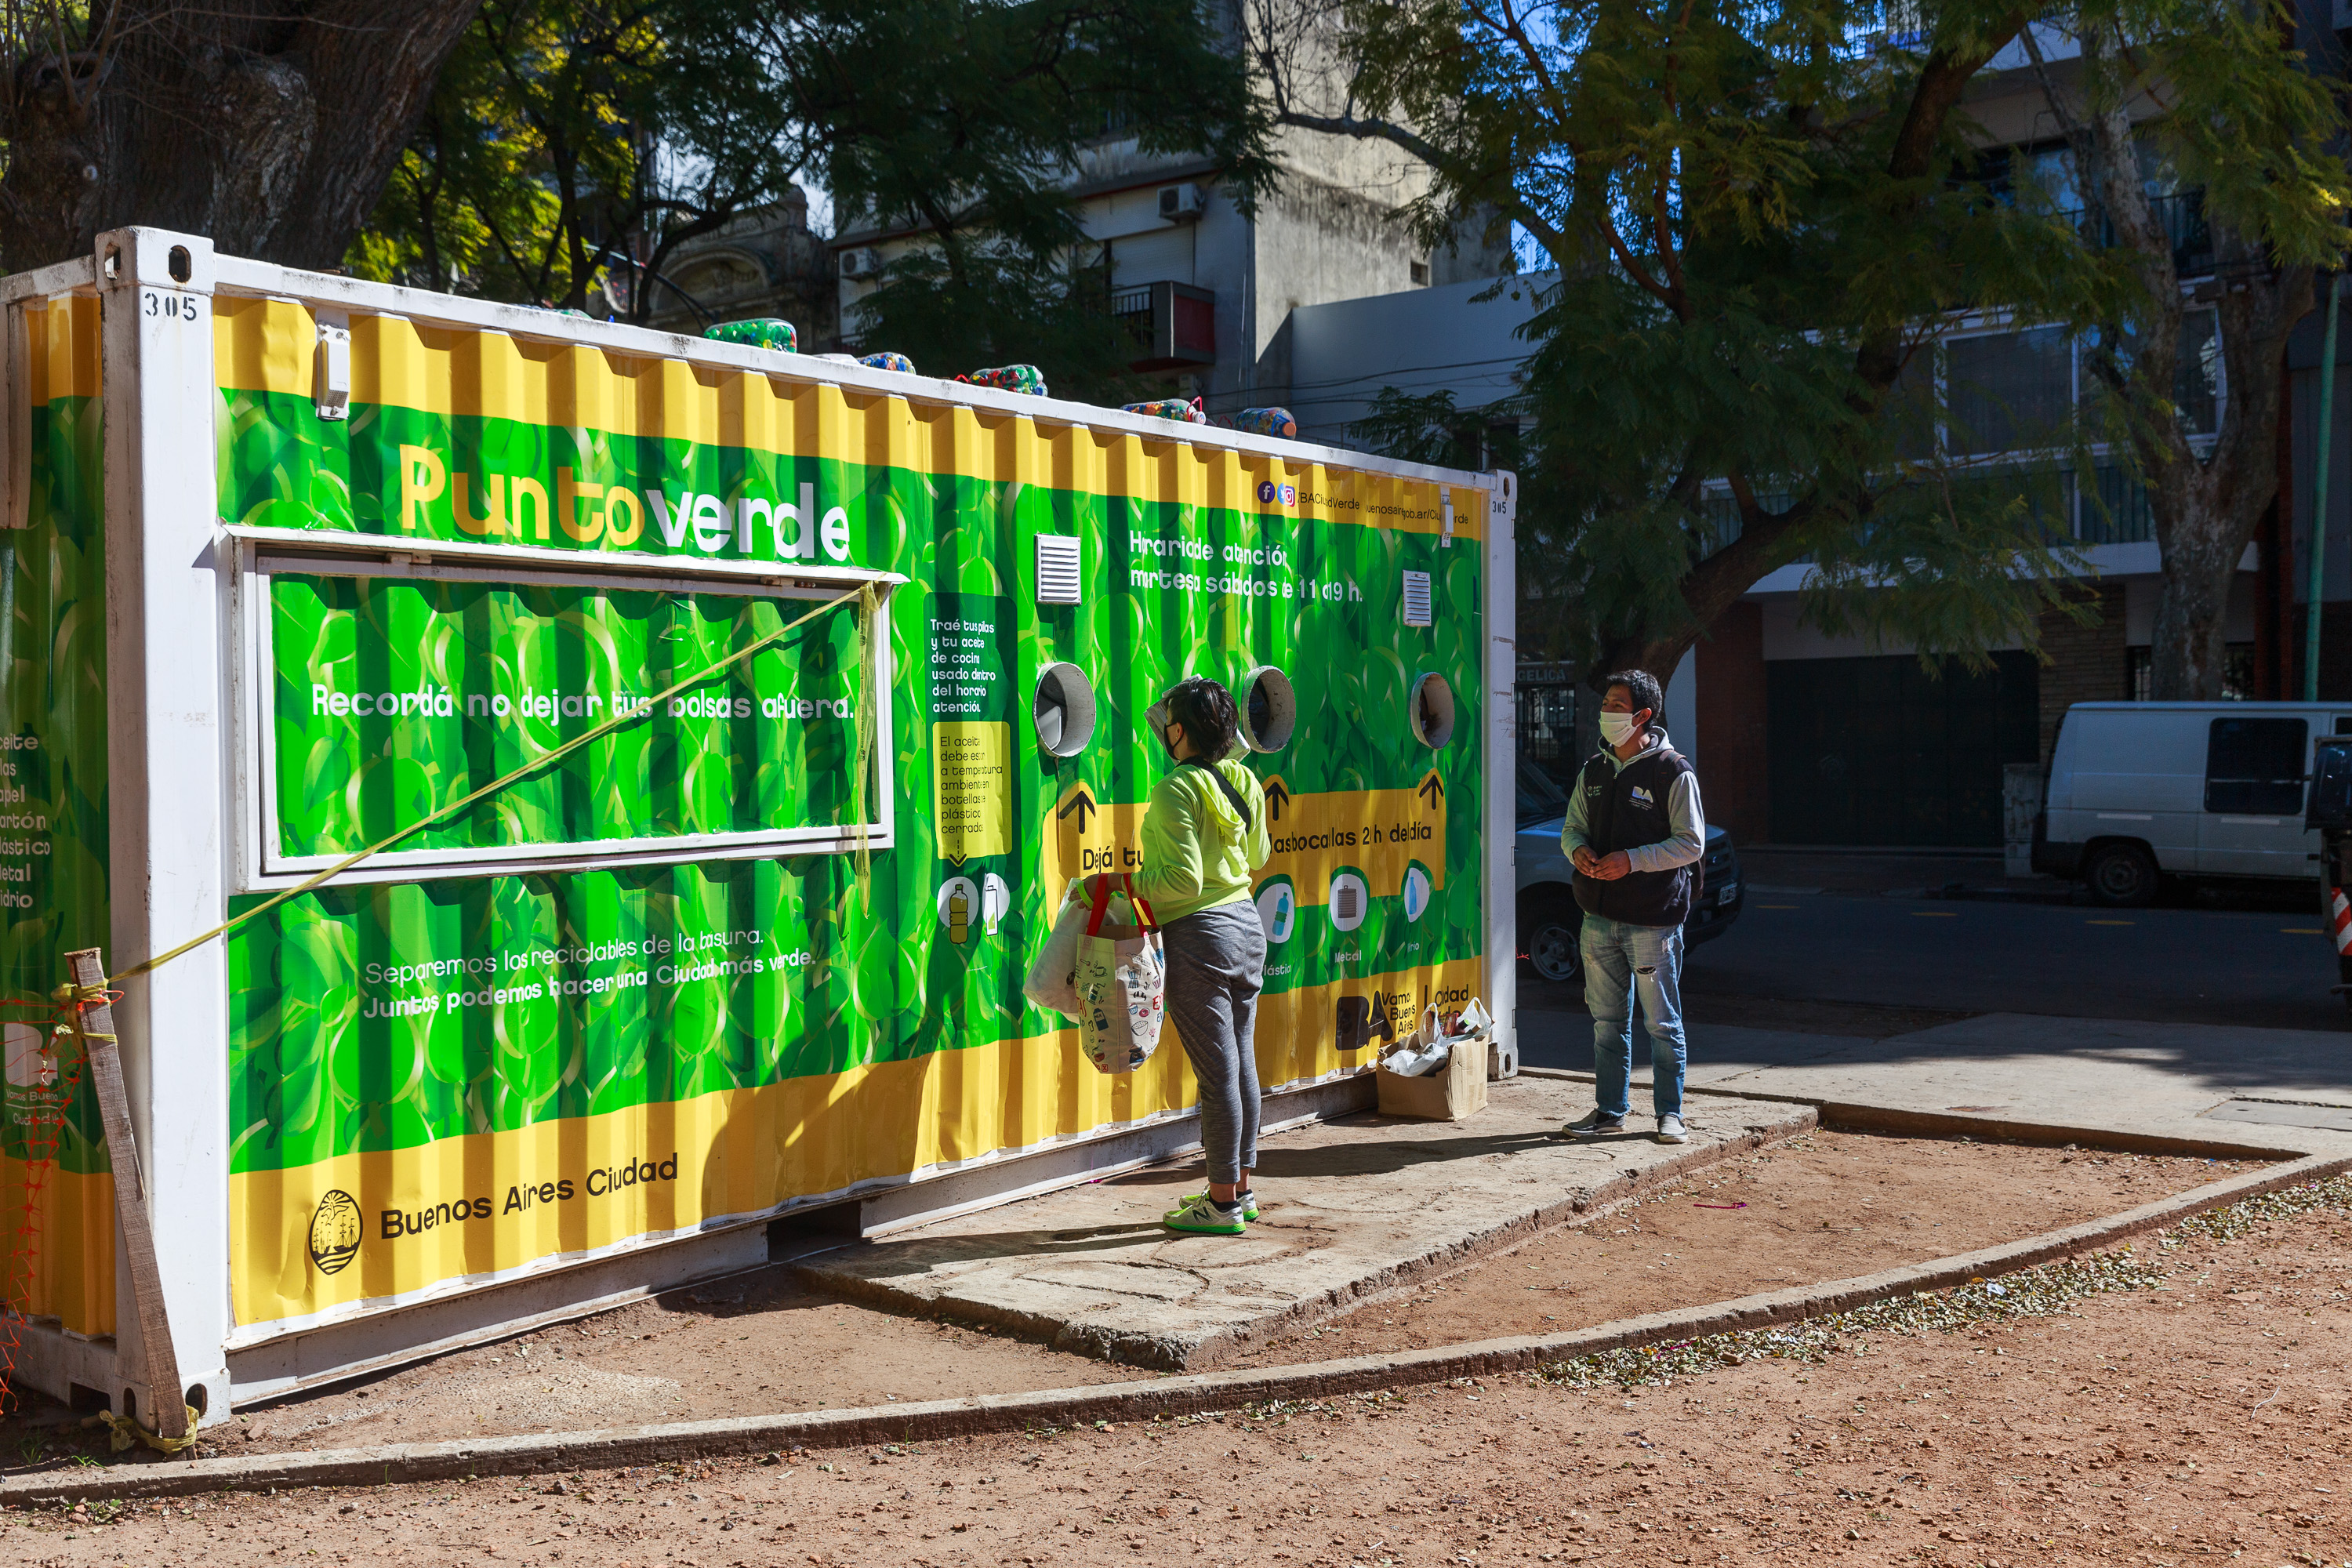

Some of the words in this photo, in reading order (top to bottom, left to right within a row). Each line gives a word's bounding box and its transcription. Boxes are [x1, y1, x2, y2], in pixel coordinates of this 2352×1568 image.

[145, 292, 197, 321] 305
[1492, 501, 1507, 514] 305
[1299, 579, 1316, 598] 11
[931, 619, 960, 631] Traé
[964, 620, 978, 632] tus
[931, 637, 938, 651] y
[942, 637, 957, 648] tu
[931, 652, 947, 663] de
[932, 668, 969, 681] usado
[932, 684, 951, 696] del
[313, 684, 453, 717] Recordá
[468, 694, 510, 717] no
[521, 686, 603, 726] dejar
[668, 688, 751, 719] bolsas
[762, 692, 854, 719] afuera.
[941, 736, 950, 746] El
[941, 750, 968, 761] debe
[1332, 827, 1356, 847] las
[1374, 824, 1382, 844] h
[1410, 821, 1432, 840] día
[1083, 846, 1112, 873] Dejá
[0, 863, 31, 882] etal
[365, 957, 497, 988] Separemos
[504, 949, 528, 971] los
[531, 938, 637, 967] reciclables
[642, 934, 671, 954] de
[678, 933, 695, 953] la
[699, 930, 764, 950] basura.
[1334, 949, 1362, 964] Metal
[364, 995, 439, 1018] Juntos
[447, 982, 542, 1014] podemos
[549, 975, 614, 996] hacer
[617, 971, 648, 989] una
[655, 958, 714, 985] Ciudad
[720, 955, 764, 976] más
[769, 947, 816, 972] verde.
[13, 1112, 50, 1126] Ciudd
[381, 1196, 492, 1240] Buenos
[503, 1179, 574, 1215] Aires
[586, 1152, 678, 1196] Ciudad
